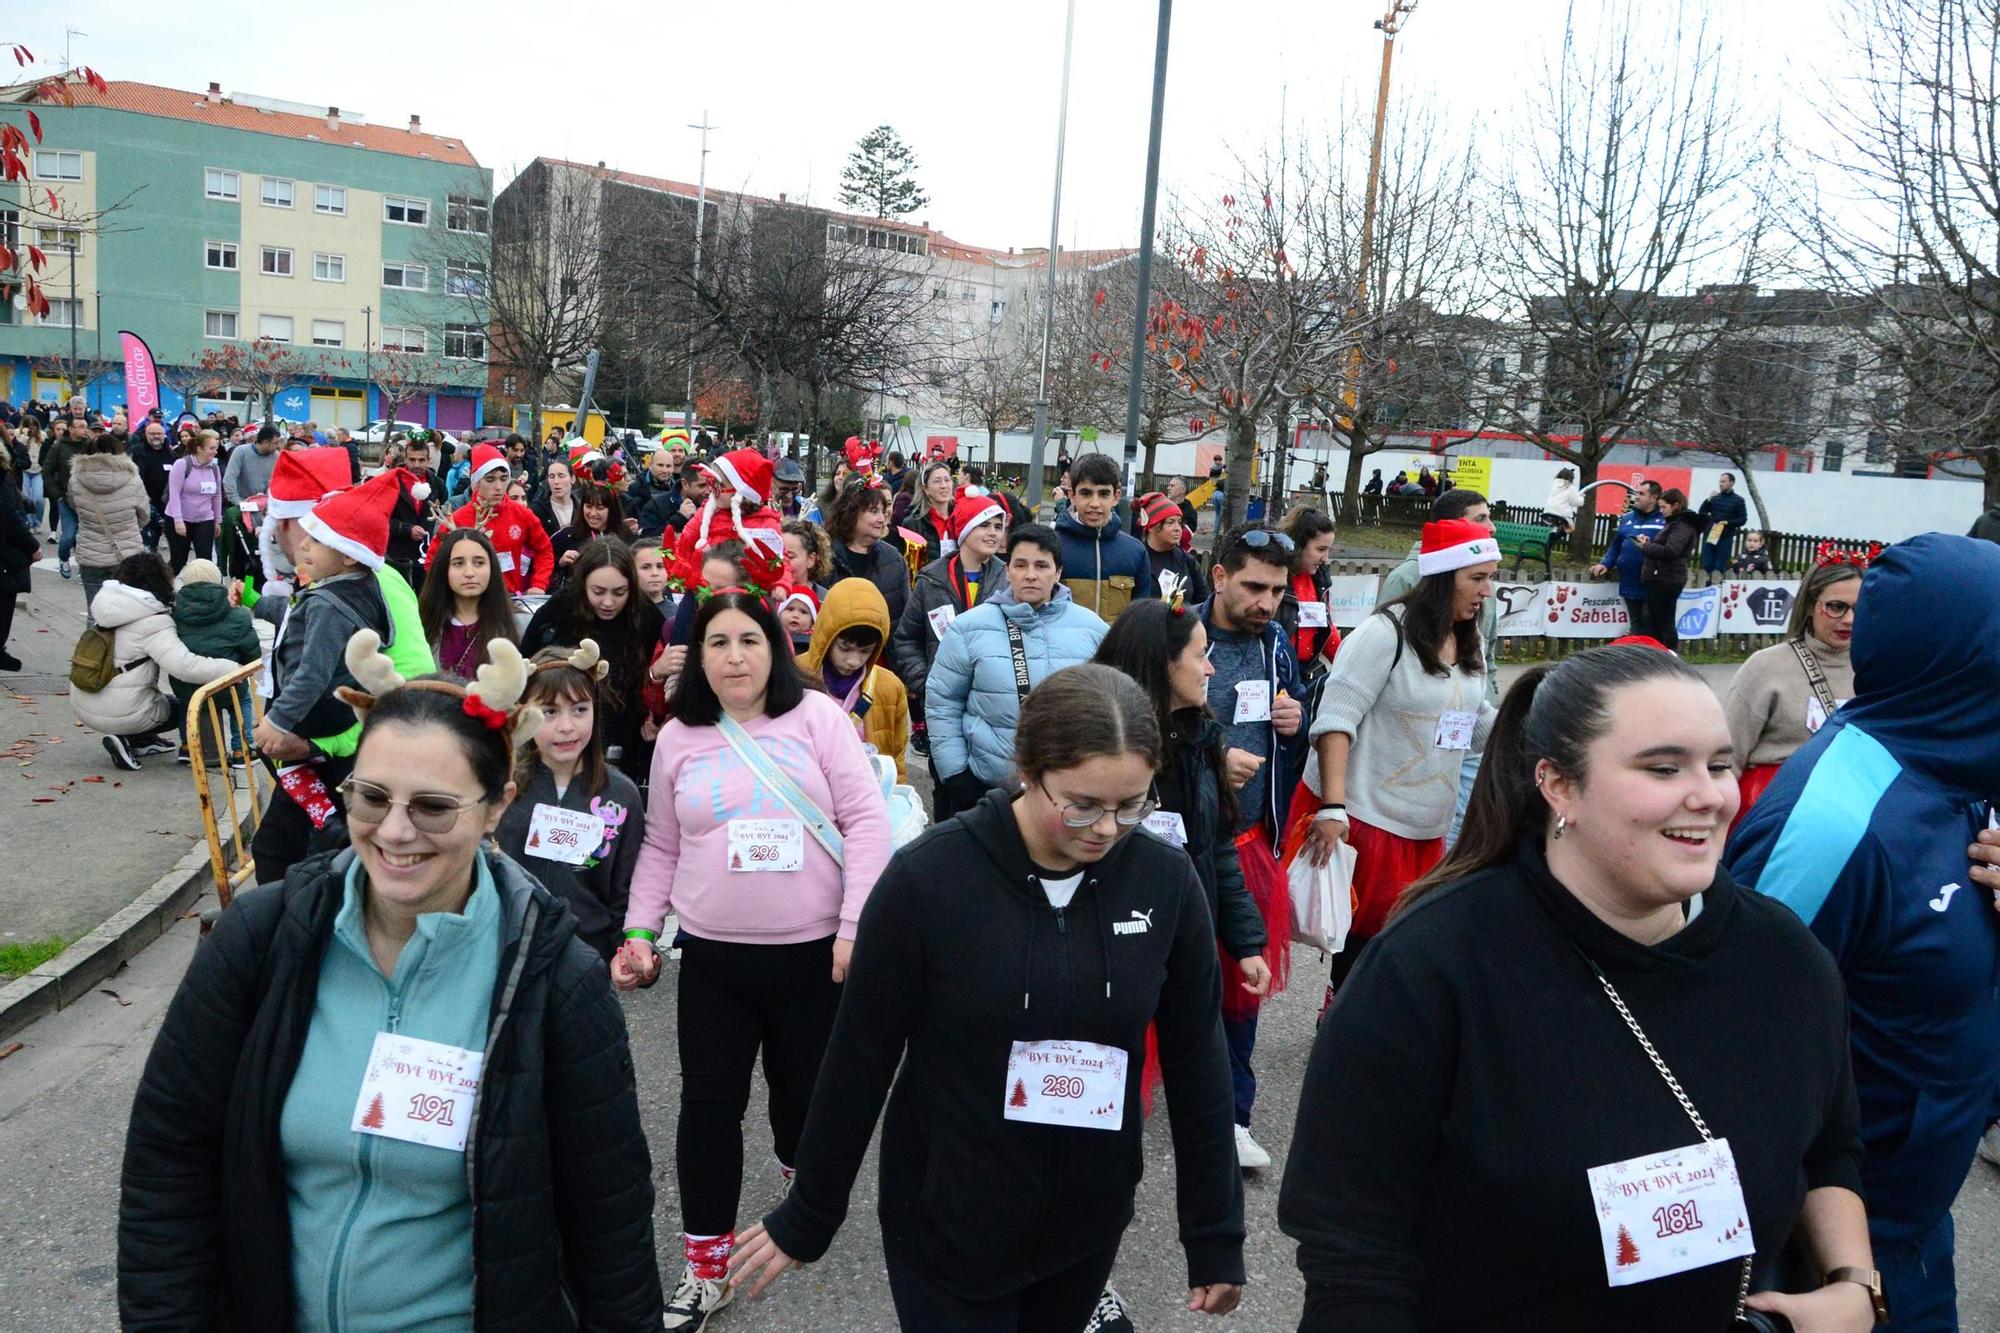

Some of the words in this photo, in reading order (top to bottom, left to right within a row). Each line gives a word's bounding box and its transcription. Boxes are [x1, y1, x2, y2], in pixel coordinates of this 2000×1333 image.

[1458, 459, 1477, 467] ENTA
[1582, 597, 1621, 606] Pescados
[1570, 608, 1628, 623] Sabela
[1012, 646, 1029, 687] BIMBAY
[548, 828, 578, 847] 274
[749, 845, 779, 861] 296
[1112, 920, 1148, 935] PUMA
[1027, 1052, 1051, 1066] BYE
[1054, 1053, 1078, 1068] BYE
[1080, 1058, 1103, 1070] 2024
[394, 1061, 422, 1079] BYE
[427, 1069, 455, 1086] BYE
[458, 1078, 479, 1089] 202
[1041, 1075, 1084, 1098] 230
[407, 1093, 455, 1126] 191
[1619, 1178, 1652, 1200] BYE
[1652, 1171, 1683, 1193] BYE
[1687, 1167, 1716, 1182] 2024
[1652, 1200, 1704, 1238] 181
